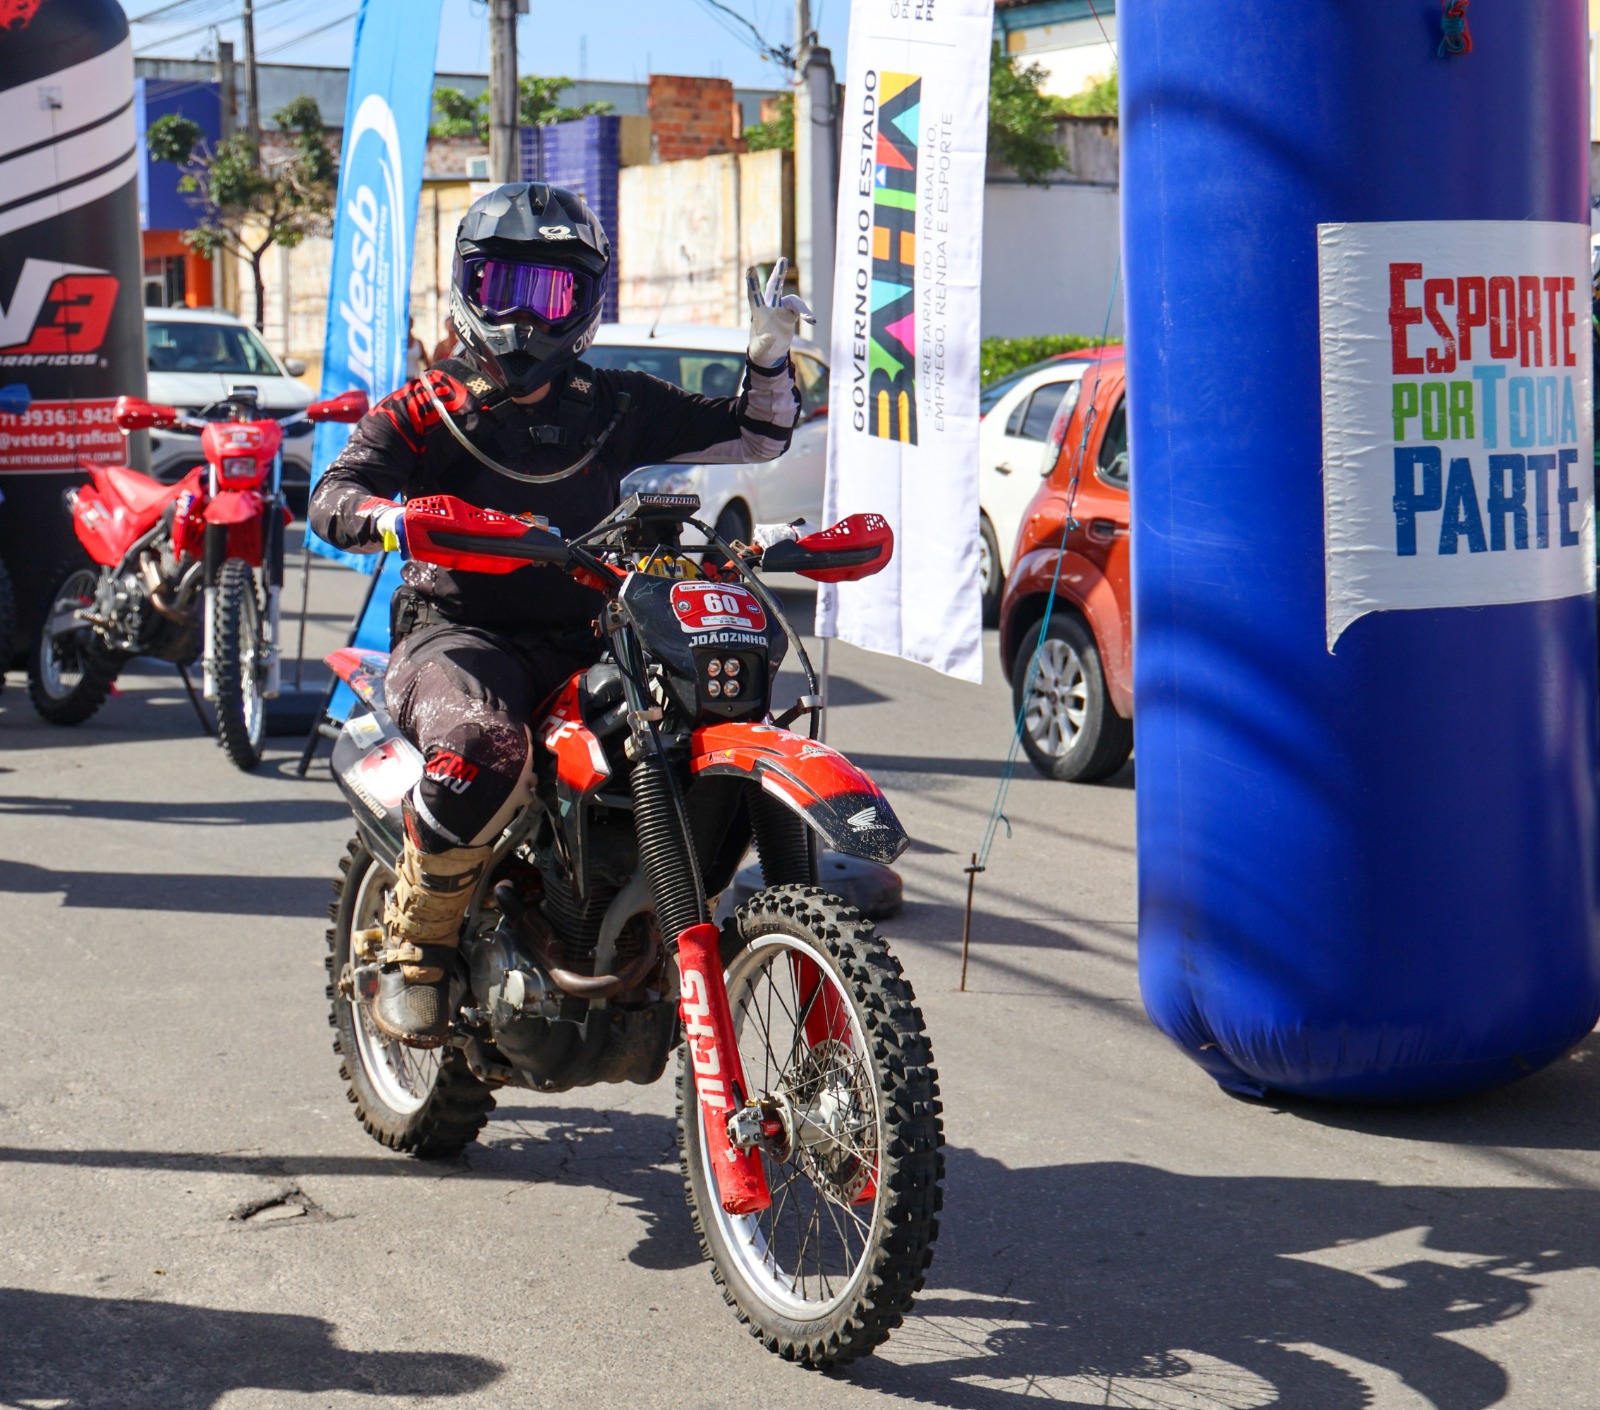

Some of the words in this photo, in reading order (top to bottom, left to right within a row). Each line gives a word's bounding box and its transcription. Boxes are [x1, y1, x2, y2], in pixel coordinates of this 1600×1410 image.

[859, 69, 877, 198] ESTADO
[924, 123, 938, 243] TRABALHO,
[938, 112, 953, 214] ESPORTE
[857, 209, 870, 257] DO
[868, 76, 922, 446] BAHIA
[923, 252, 933, 281] DO
[935, 240, 948, 315] RENDA
[937, 222, 949, 234] E
[852, 267, 868, 432] GOVERNO
[922, 287, 932, 417] SECRETARIA
[1388, 263, 1576, 375] ESPORTE
[934, 324, 946, 433] EMPREGO,
[1392, 381, 1475, 441] POR
[1393, 446, 1579, 556] PARTE
[688, 631, 768, 648] JOÃOZINHO
[703, 592, 740, 614] 60
[851, 824, 890, 833] HONDA
